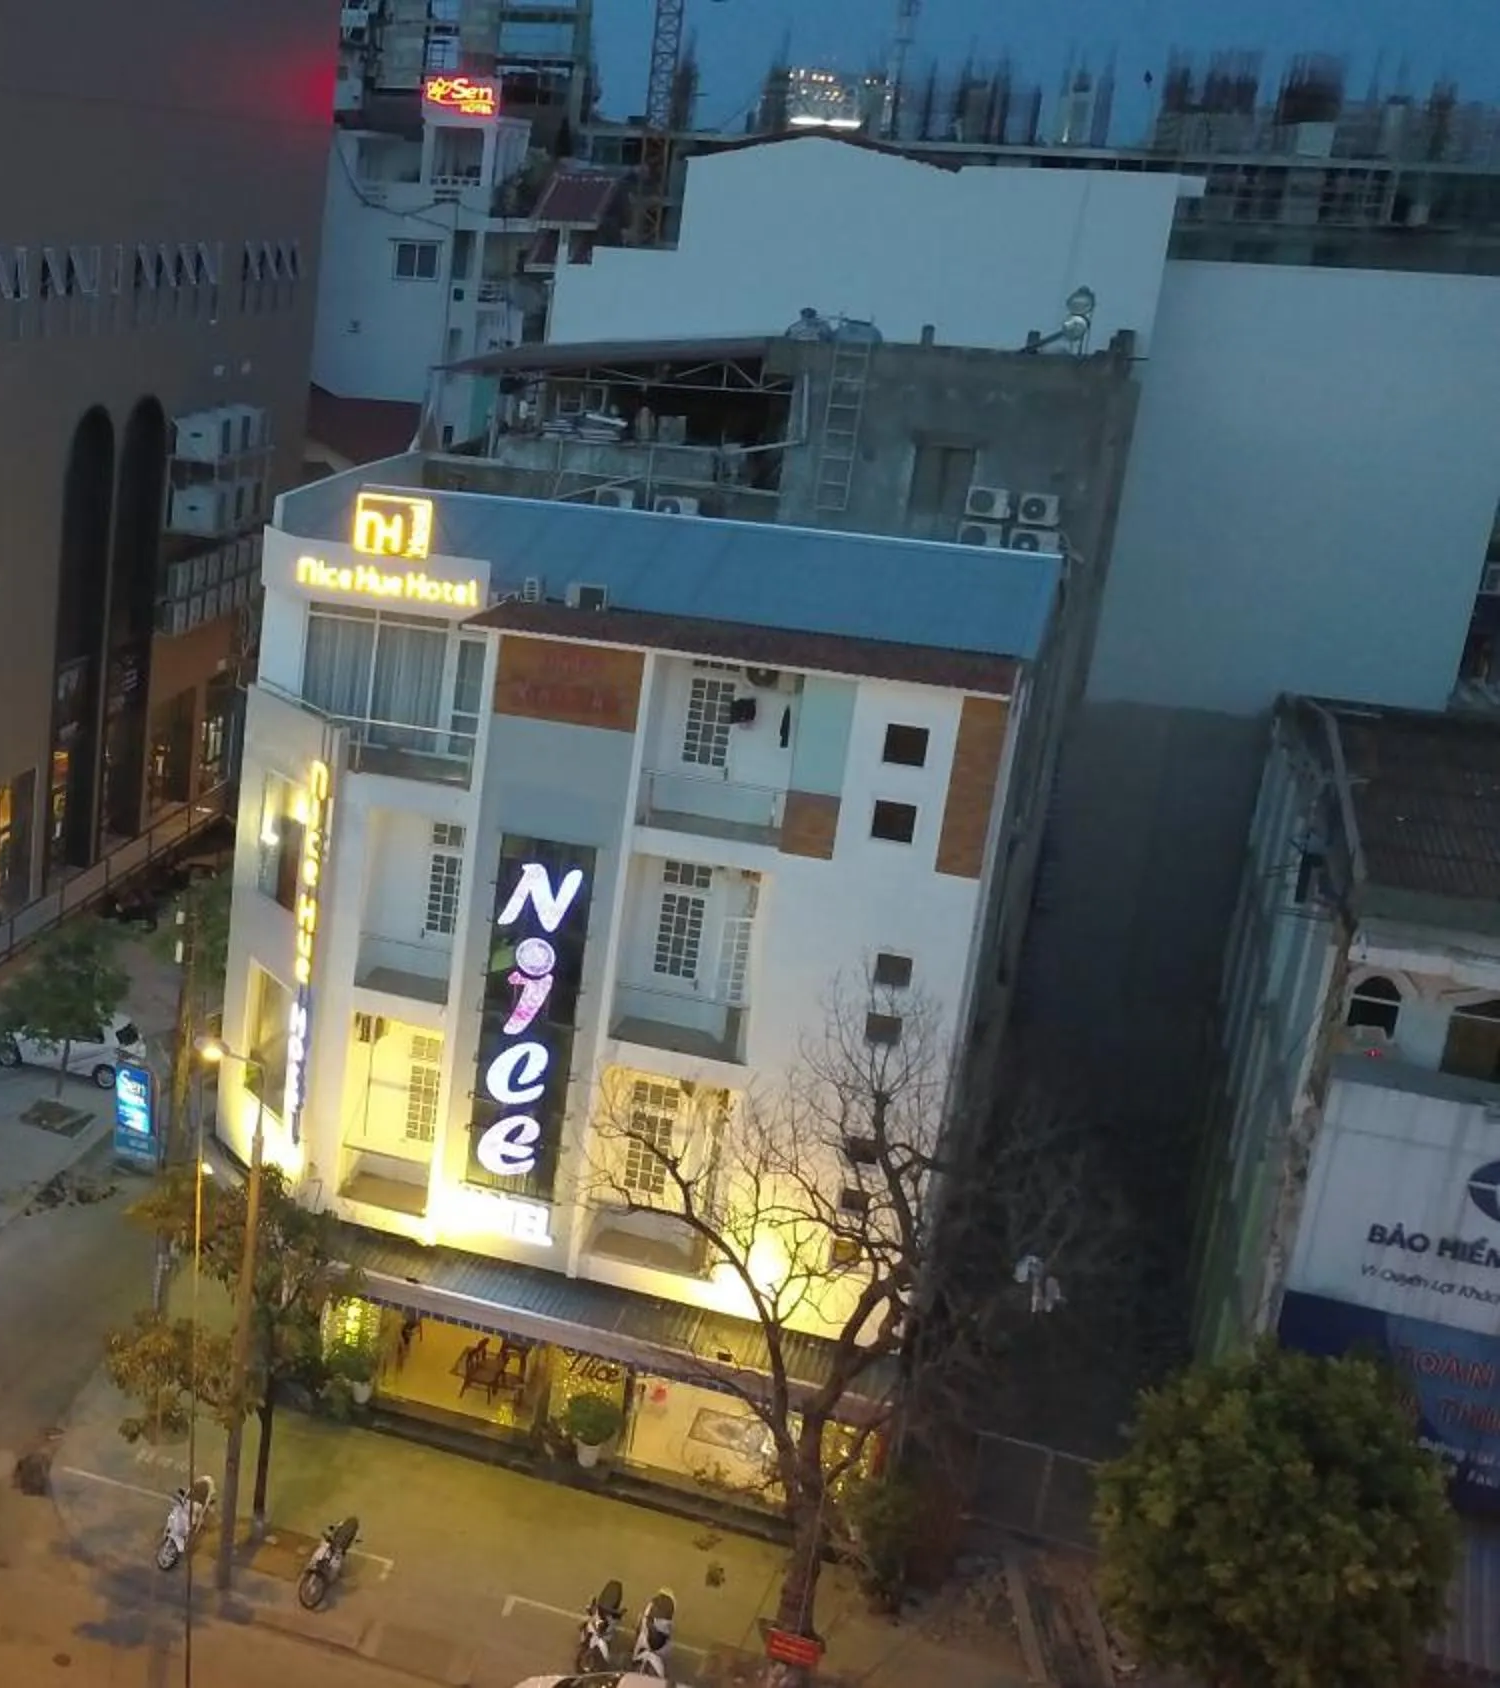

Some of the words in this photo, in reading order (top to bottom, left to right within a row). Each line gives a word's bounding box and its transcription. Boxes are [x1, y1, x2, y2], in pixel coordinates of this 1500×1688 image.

[451, 77, 494, 101] Sen
[354, 563, 404, 597] Hue
[405, 571, 478, 607] Hotel
[476, 863, 584, 1176] Nice
[1367, 1222, 1431, 1254] BẢO
